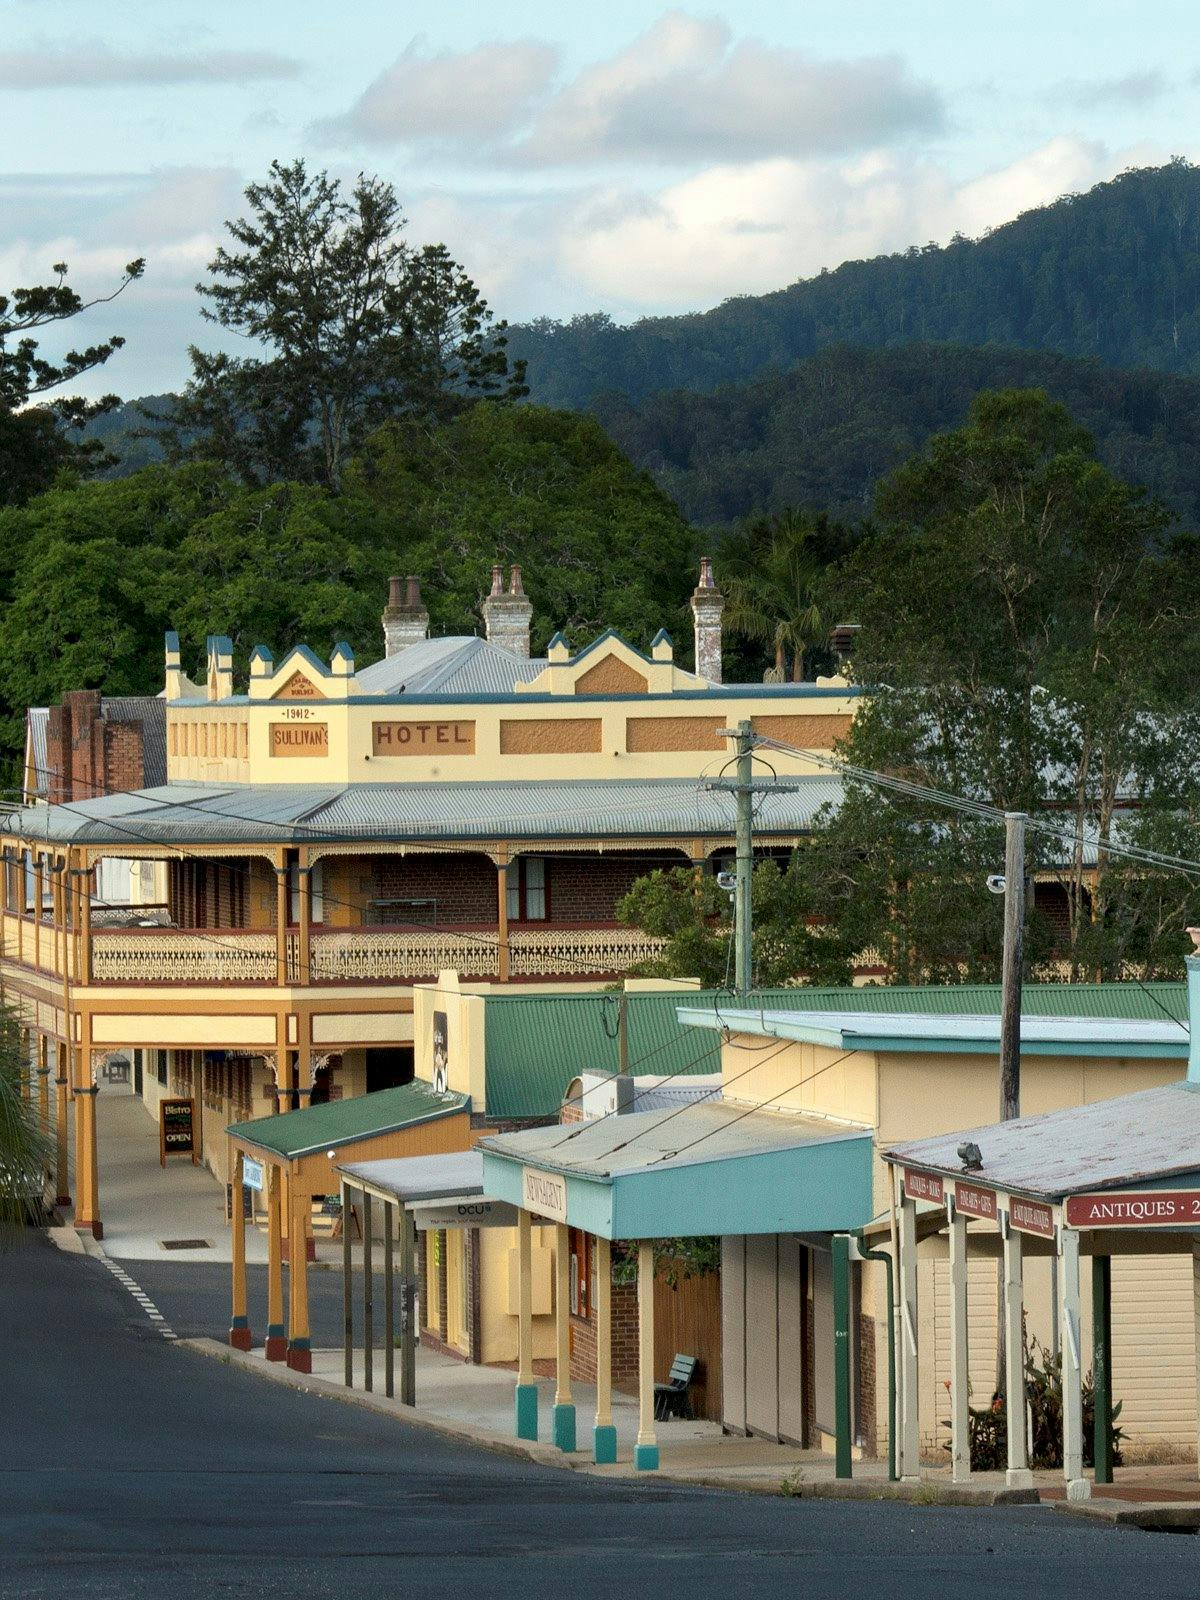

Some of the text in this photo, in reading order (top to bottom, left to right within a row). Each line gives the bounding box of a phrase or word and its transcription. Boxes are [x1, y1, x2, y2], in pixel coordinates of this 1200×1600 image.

[166, 1134, 191, 1142] OPEN
[526, 1174, 562, 1210] NEWSAGENT
[1089, 1200, 1175, 1219] ANTIQUES
